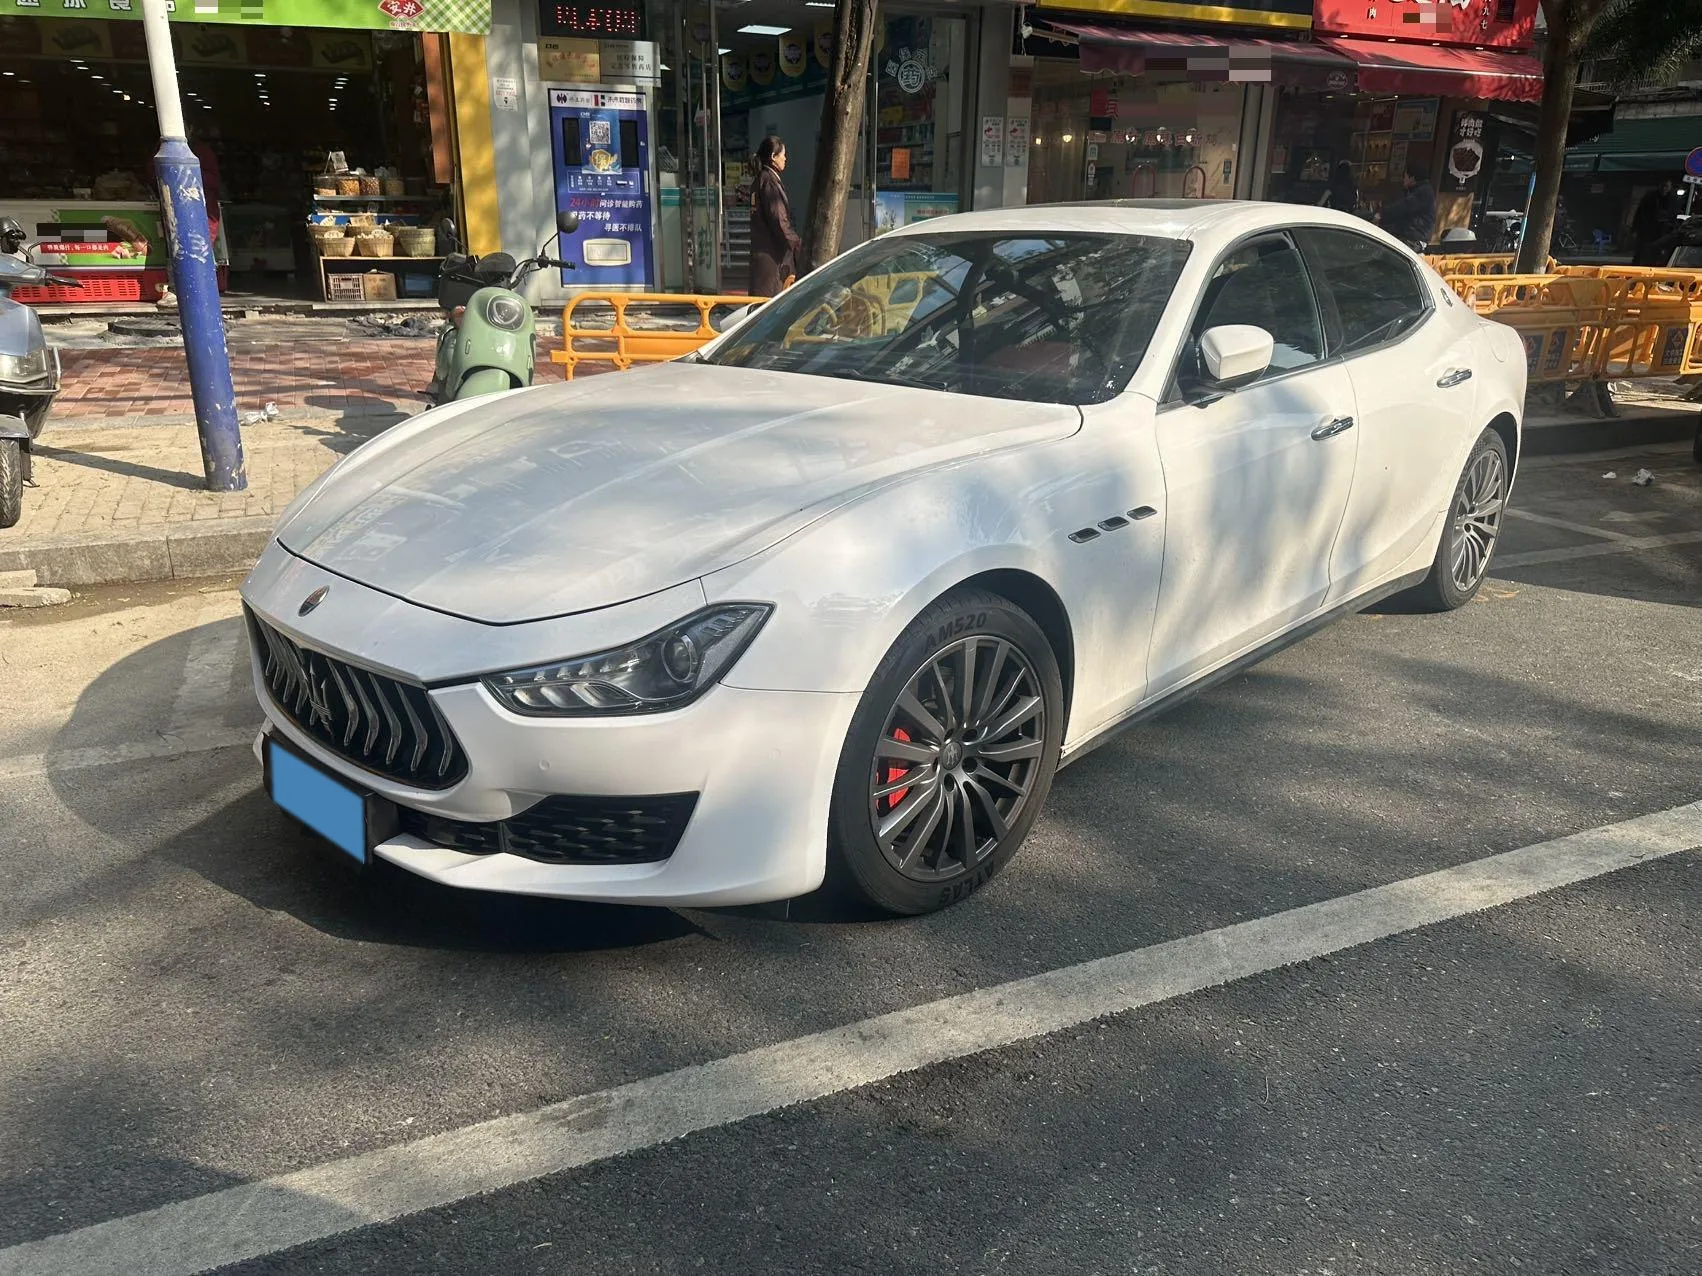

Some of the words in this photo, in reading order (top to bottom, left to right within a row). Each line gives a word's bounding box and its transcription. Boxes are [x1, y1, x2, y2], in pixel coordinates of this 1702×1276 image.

[387, 0, 417, 15] 安井
[604, 223, 642, 232] 寻医不排队
